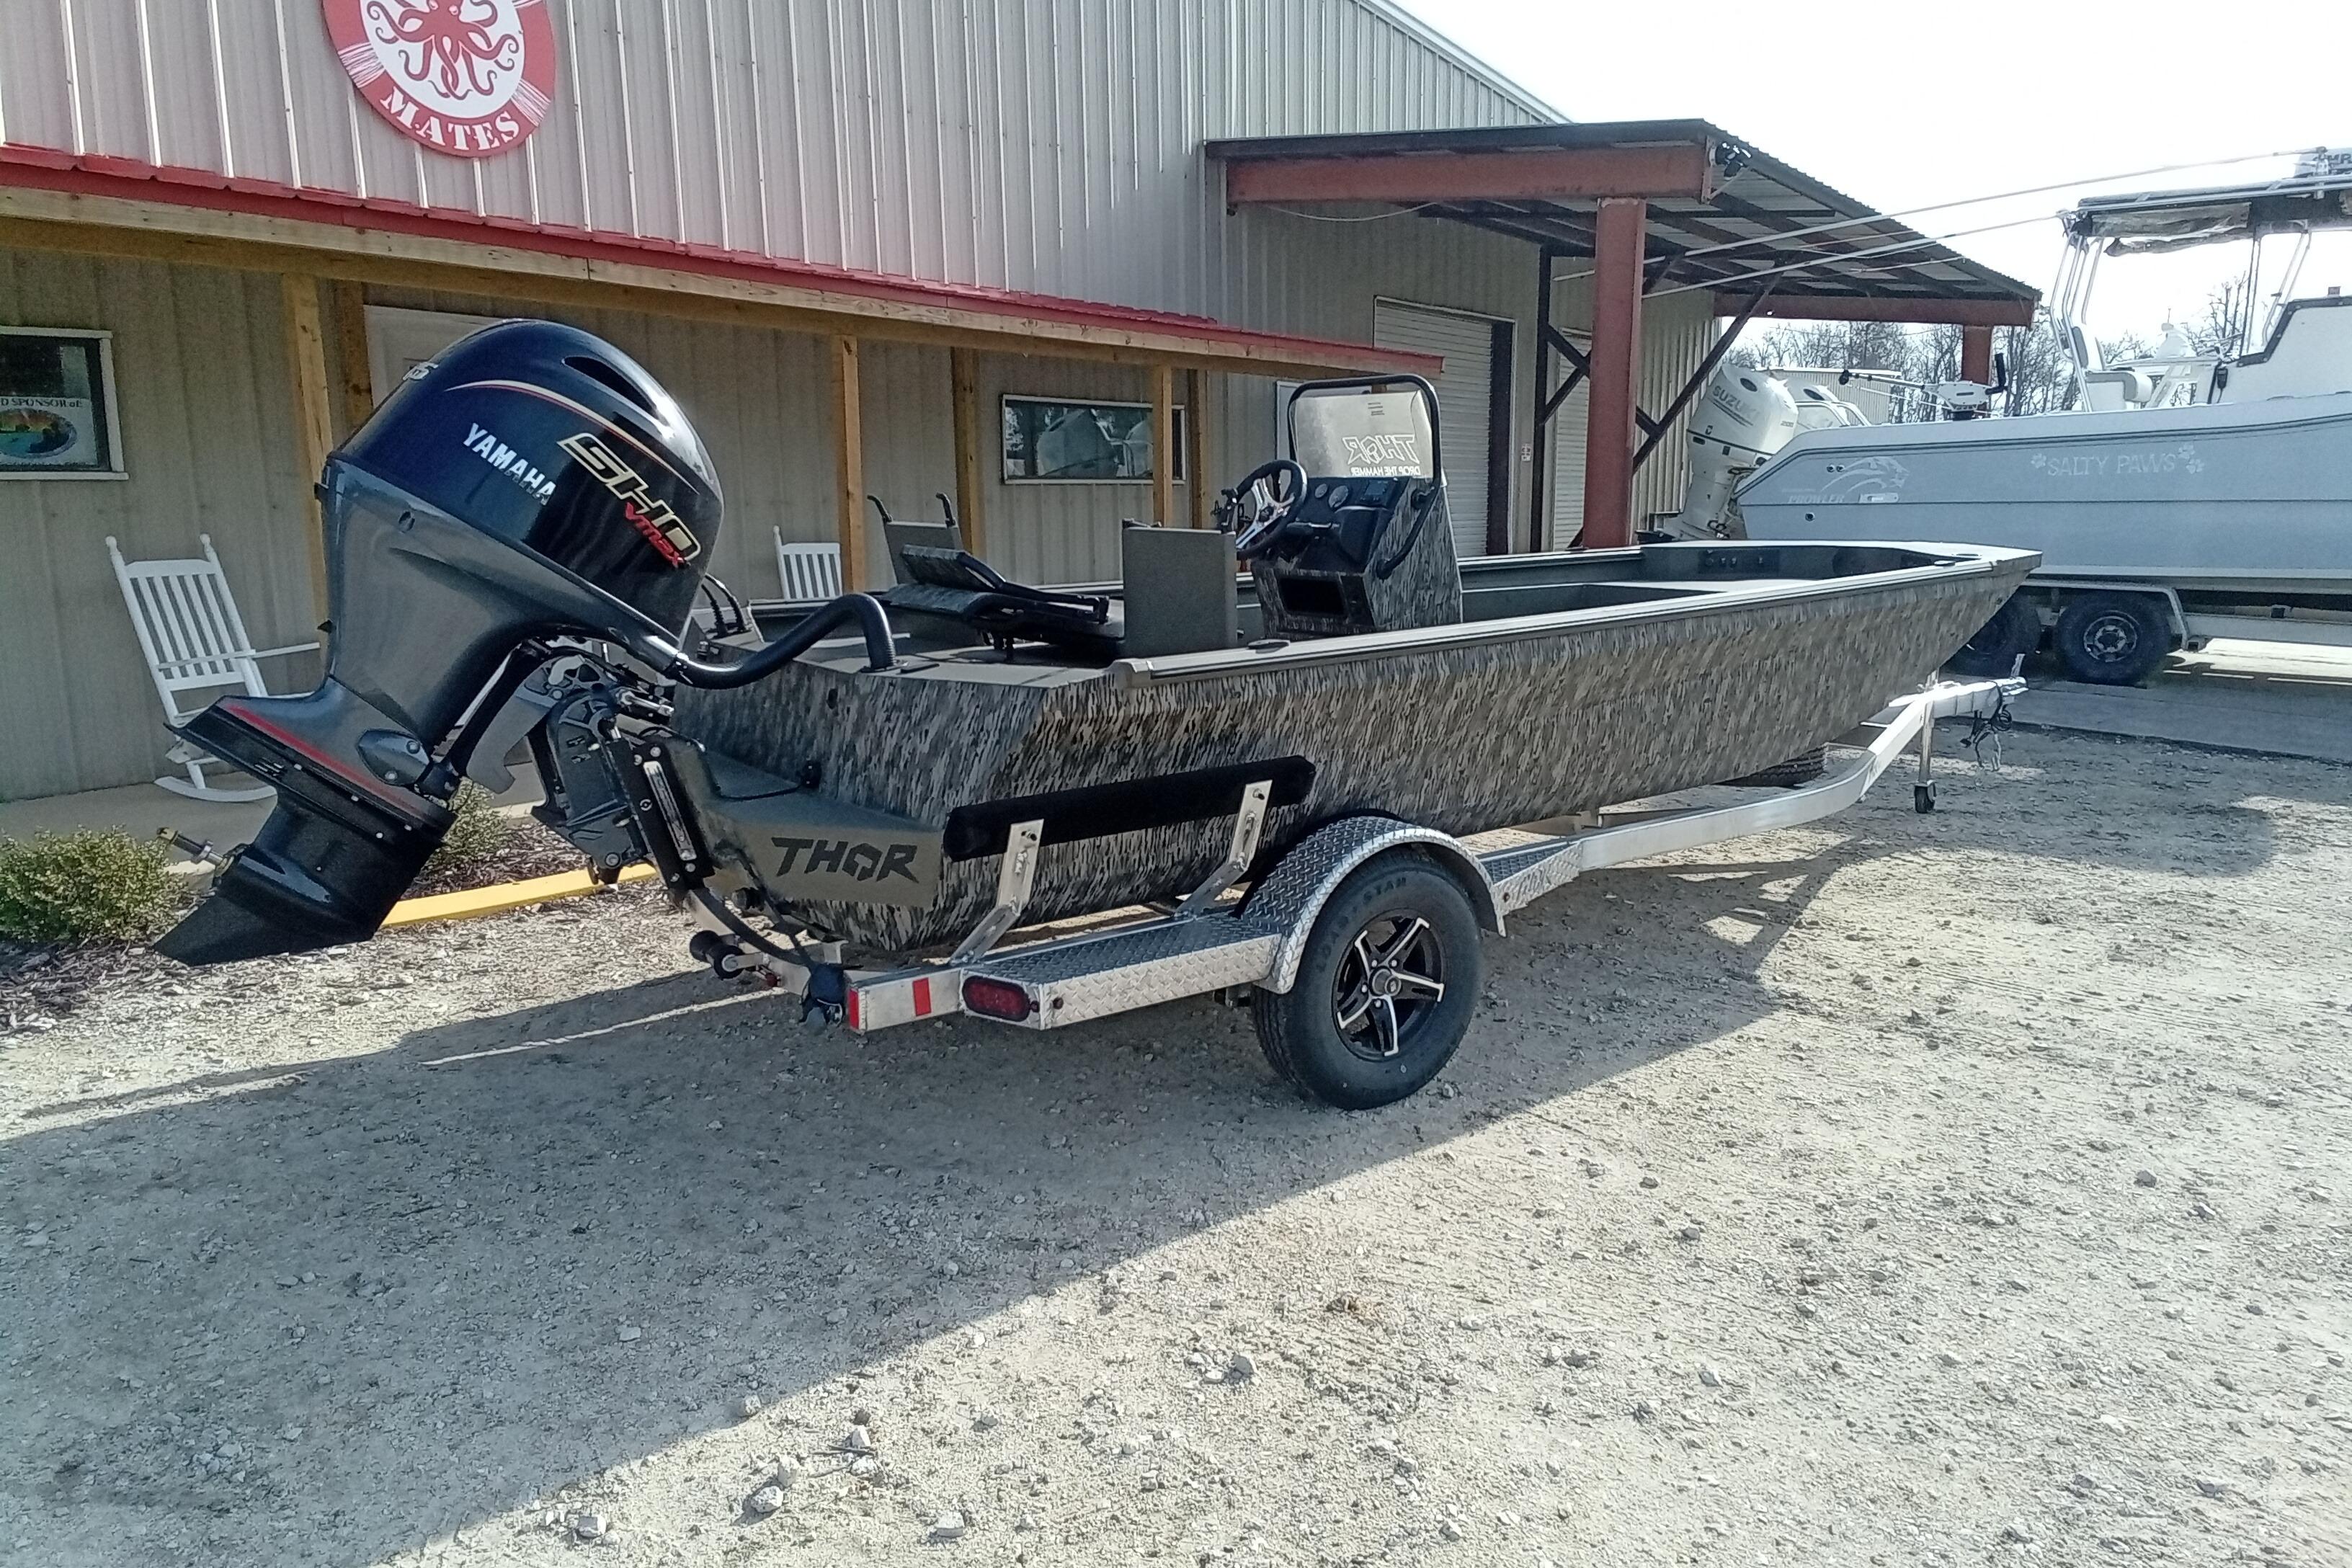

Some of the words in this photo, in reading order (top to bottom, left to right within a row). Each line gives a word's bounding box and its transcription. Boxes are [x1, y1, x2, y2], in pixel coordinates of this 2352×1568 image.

[379, 86, 520, 151] MATES
[463, 422, 557, 504] YAMAHA
[2047, 455, 2110, 476] SALTY
[2116, 453, 2177, 474] PAWS
[556, 432, 702, 561] SHO
[771, 837, 919, 884] THOR
